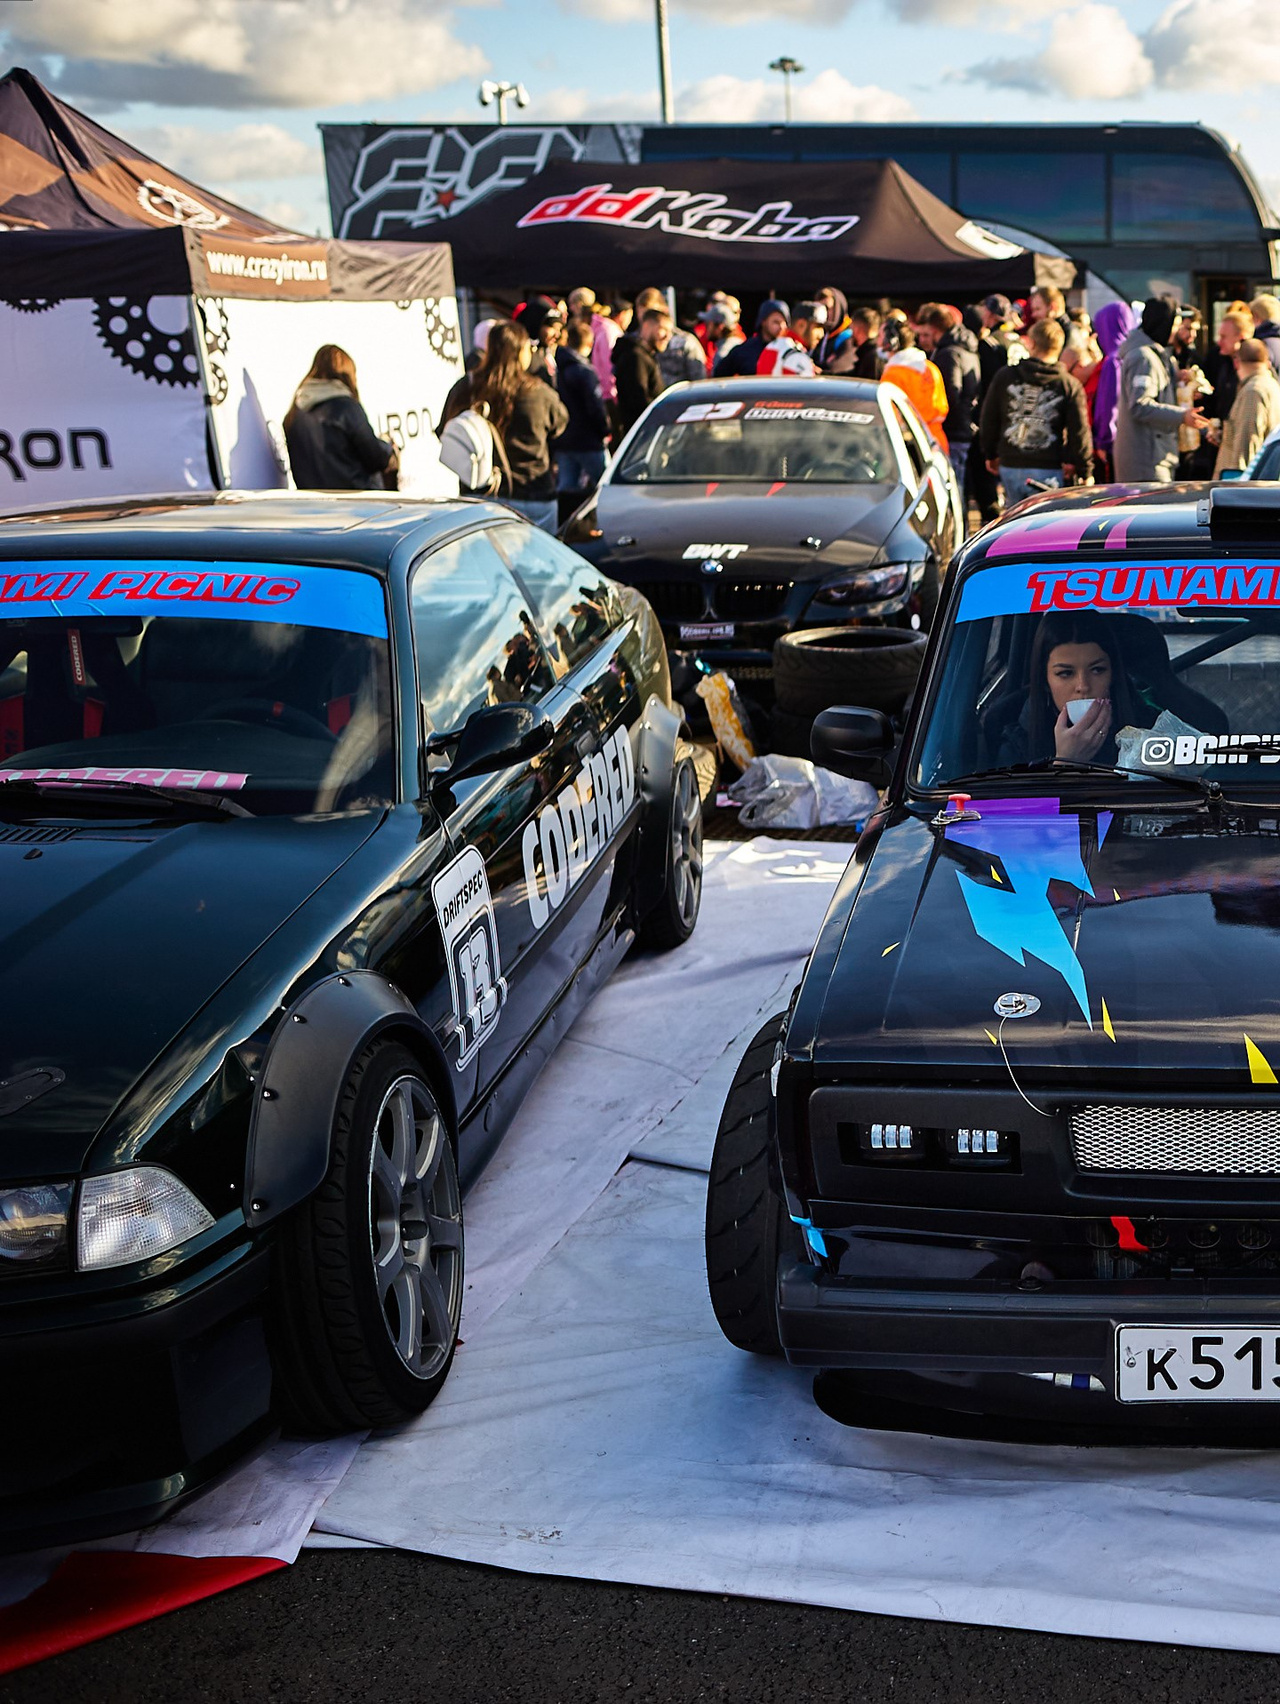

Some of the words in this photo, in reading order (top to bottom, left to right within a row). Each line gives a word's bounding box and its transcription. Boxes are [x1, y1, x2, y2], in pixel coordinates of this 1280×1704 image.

[0, 571, 90, 603] MI
[89, 571, 301, 605] PICNIC
[71, 635, 83, 682] CODERED
[521, 723, 635, 930] CODERED
[442, 869, 484, 930] DRIFTSPEC
